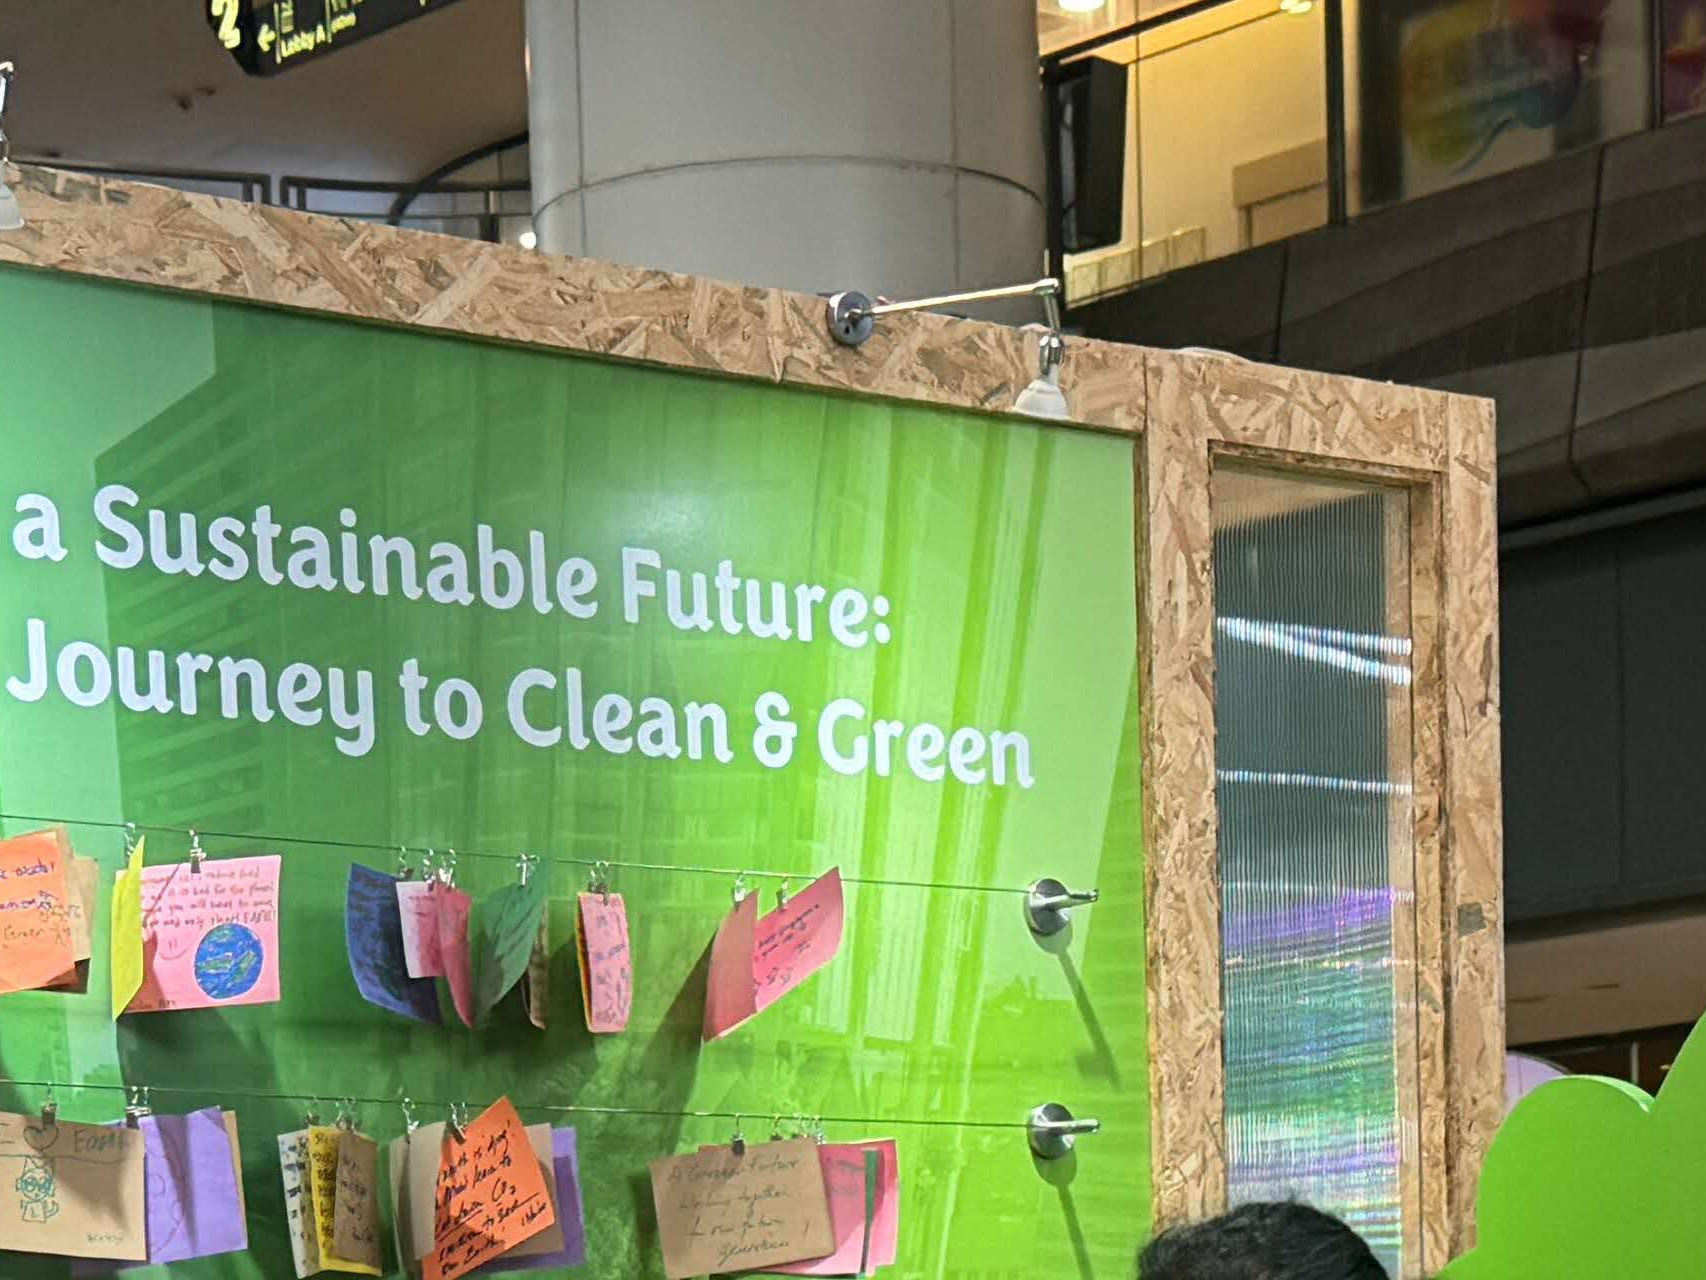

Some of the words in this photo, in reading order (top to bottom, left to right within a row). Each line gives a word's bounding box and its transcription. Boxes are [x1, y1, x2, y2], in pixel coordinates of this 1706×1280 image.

[13, 494, 68, 562] a
[94, 484, 597, 619] Sustainable
[622, 548, 890, 647] Future:
[6, 618, 375, 757] Journey
[399, 658, 483, 740] to
[507, 667, 733, 763] Clean
[753, 692, 797, 768] &
[818, 699, 1034, 787] Green
